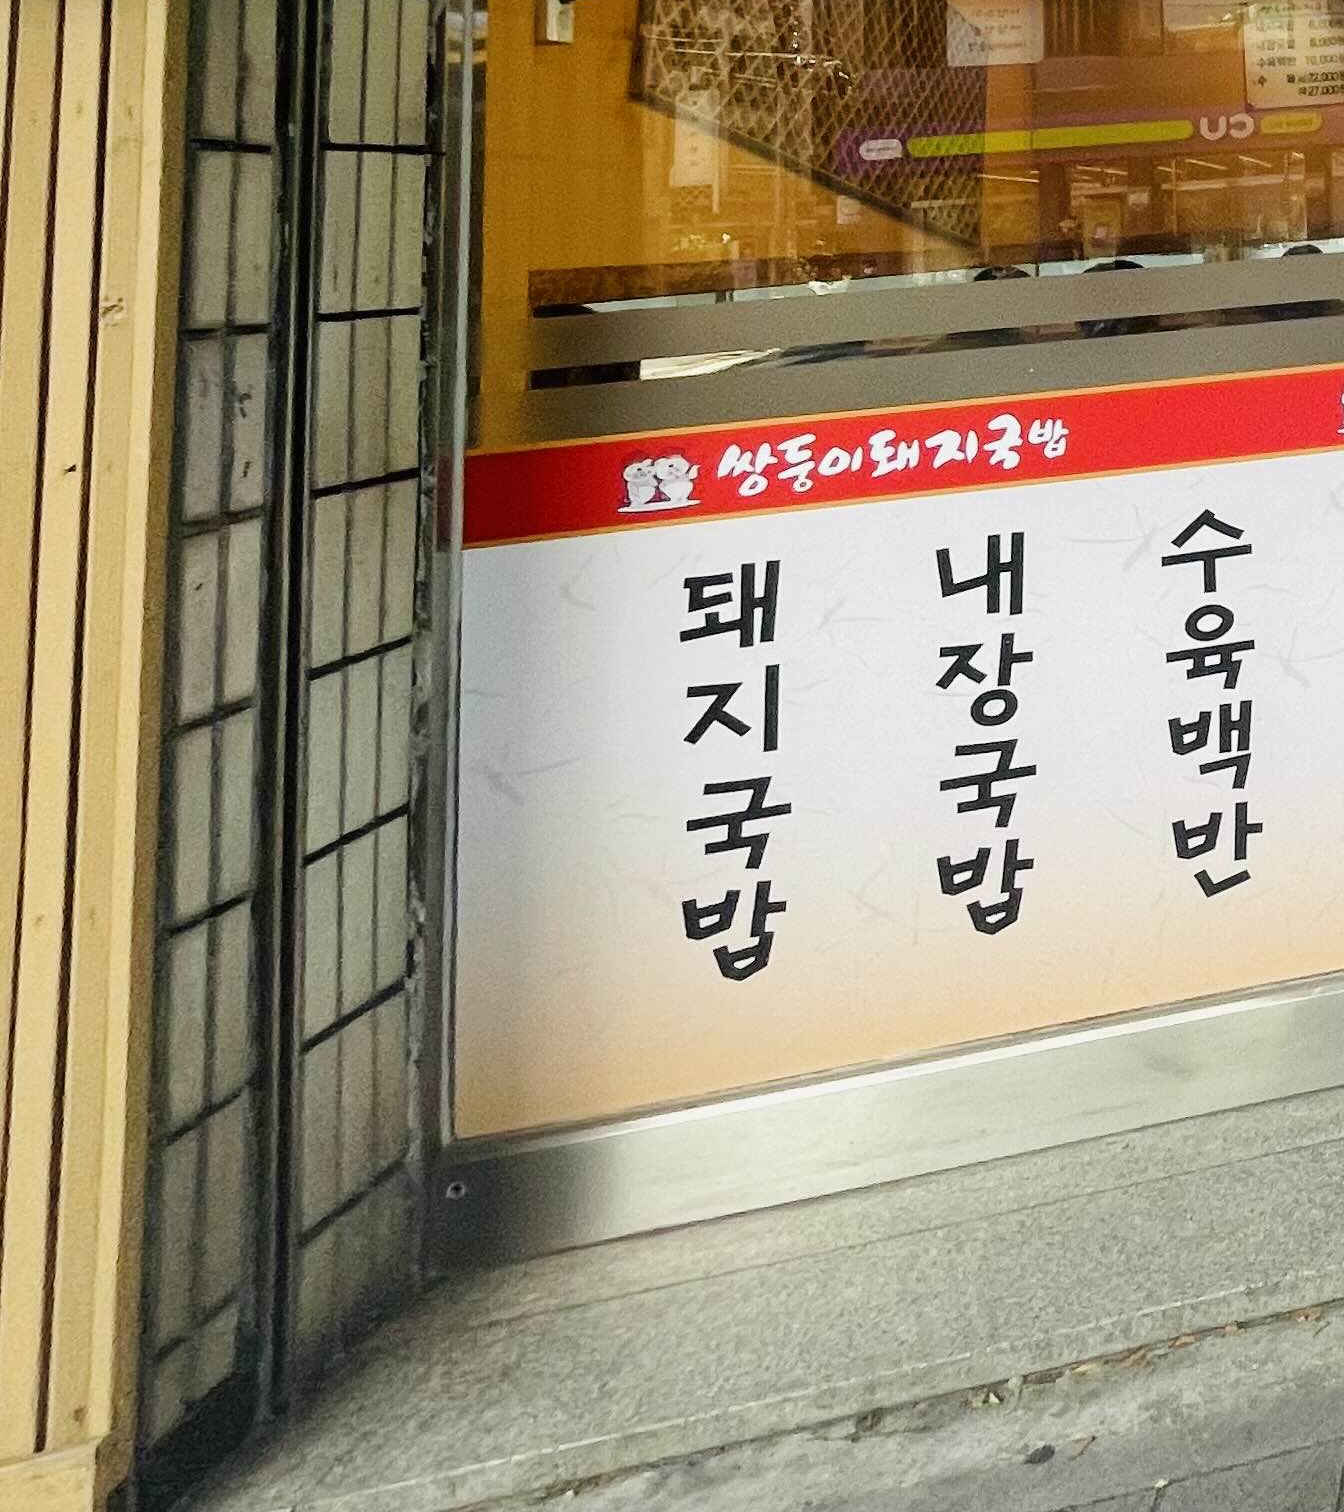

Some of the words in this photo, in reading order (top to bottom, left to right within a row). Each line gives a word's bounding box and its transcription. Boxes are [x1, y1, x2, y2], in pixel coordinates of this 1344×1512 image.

[679, 560, 792, 982] 돼지국밥
[936, 532, 1037, 936] 내장국밥
[1161, 509, 1264, 898] 수육백반
